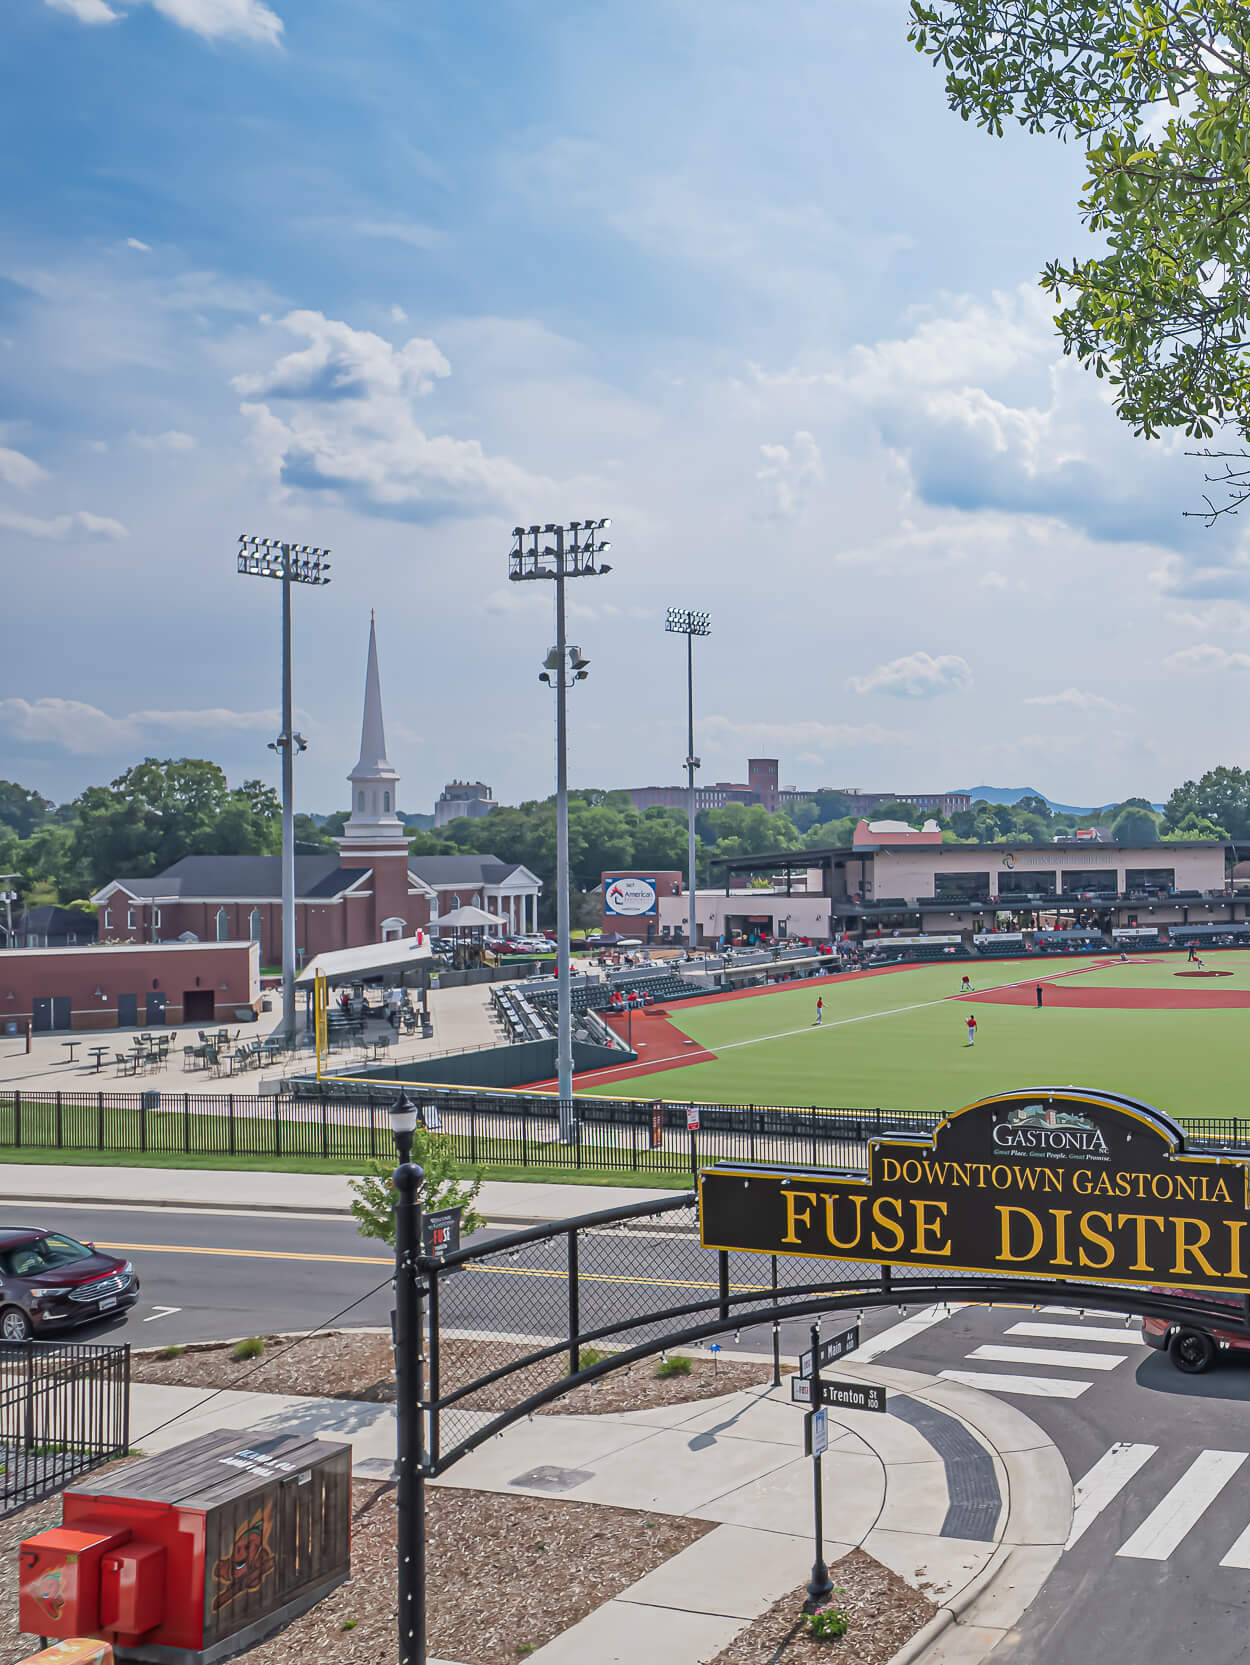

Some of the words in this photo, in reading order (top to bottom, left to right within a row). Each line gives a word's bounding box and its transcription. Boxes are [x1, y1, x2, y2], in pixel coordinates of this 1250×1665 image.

[993, 1124, 1108, 1150] GASTONIA
[1010, 1149, 1028, 1157] Place.
[1046, 1152, 1068, 1160] People.
[881, 1158, 1065, 1193] DOWNTOWN
[1072, 1169, 1233, 1203] GASTONIA
[779, 1190, 952, 1256] FUSE
[828, 1342, 841, 1359] Main
[829, 1386, 865, 1405] Trenton
[869, 1390, 877, 1399] St
[868, 1399, 879, 1409] 100
